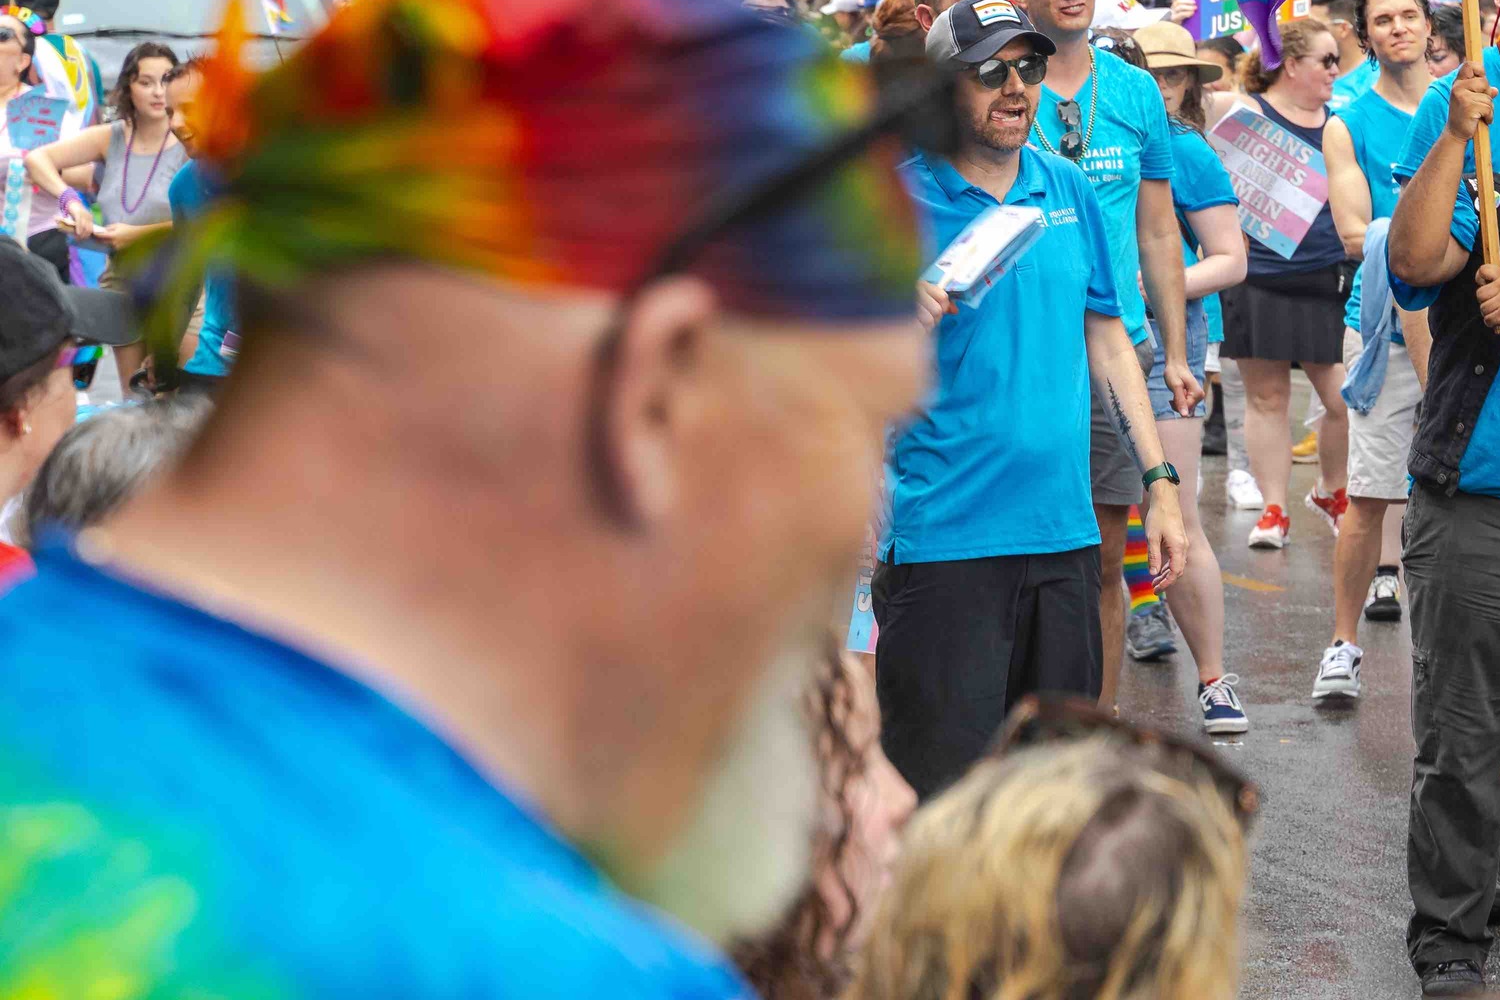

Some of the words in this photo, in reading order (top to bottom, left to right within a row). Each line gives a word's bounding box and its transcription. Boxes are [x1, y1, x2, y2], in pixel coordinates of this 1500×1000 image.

[1209, 11, 1249, 40] JUS
[1084, 147, 1122, 158] UALITY
[1248, 117, 1314, 166] TRANS
[1082, 159, 1124, 171] LINOIS
[1231, 133, 1308, 187] RIGHTS
[1237, 160, 1278, 193] ARE
[1230, 172, 1287, 222] MAN
